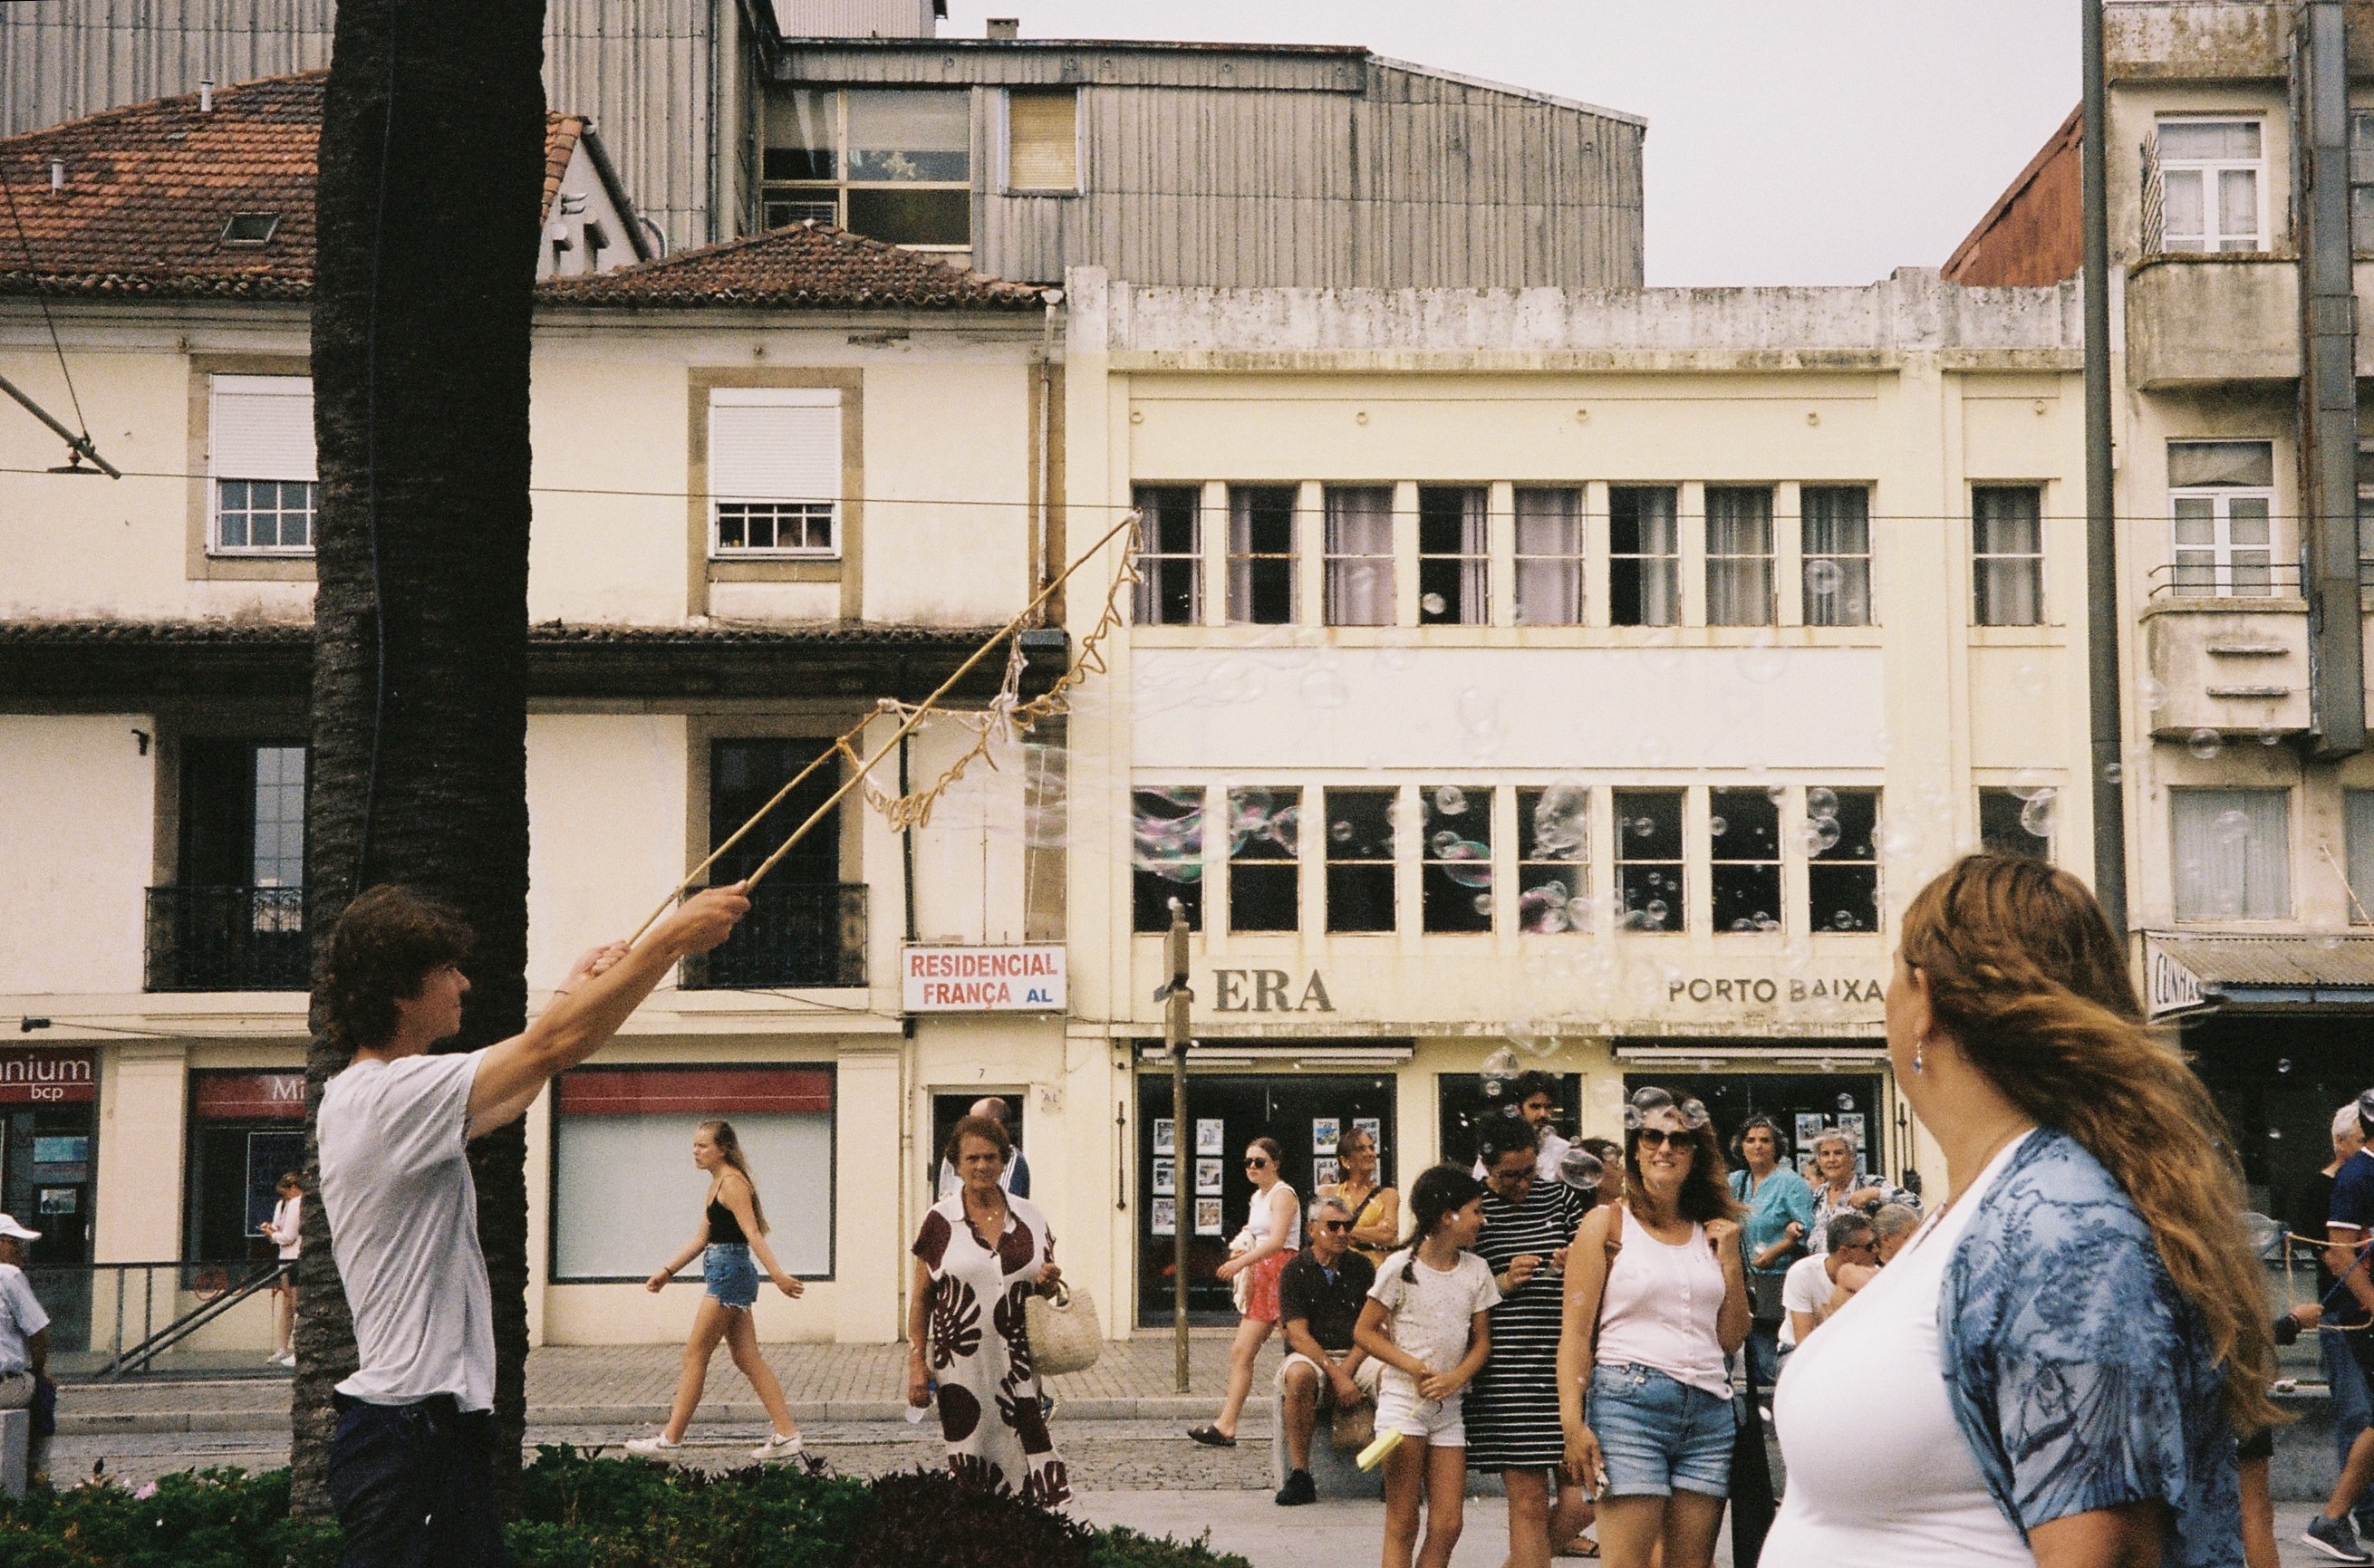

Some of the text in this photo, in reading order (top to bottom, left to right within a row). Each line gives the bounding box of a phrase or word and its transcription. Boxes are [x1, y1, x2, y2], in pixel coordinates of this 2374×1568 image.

[911, 953, 1058, 977] RESIDENCIAL
[923, 982, 1053, 1010] FRANÇA AL
[1211, 968, 1337, 1012] ERA
[1669, 978, 1886, 1003] PORTO BAIXA
[0, 1053, 91, 1081] nium
[979, 1068, 985, 1079] 7
[31, 1083, 63, 1102] bcp
